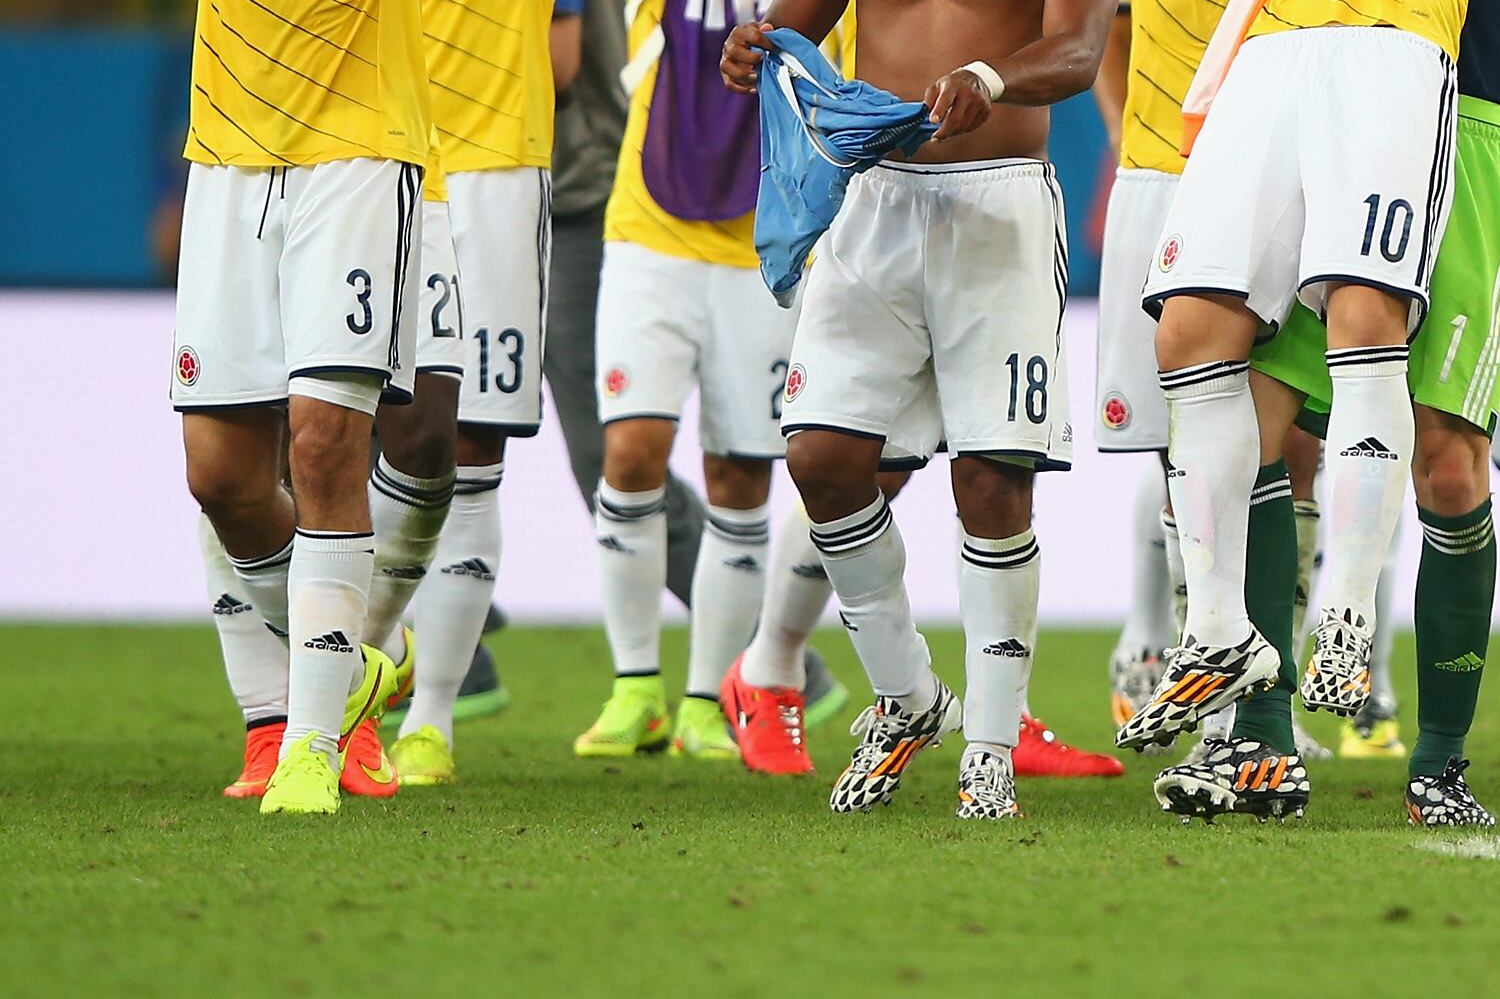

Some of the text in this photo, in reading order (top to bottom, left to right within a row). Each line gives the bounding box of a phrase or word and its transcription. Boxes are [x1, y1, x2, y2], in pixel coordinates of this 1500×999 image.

[1362, 194, 1413, 263] 10
[346, 269, 372, 335] 3
[427, 273, 463, 340] 21
[474, 328, 524, 394] 13
[1439, 314, 1468, 384] 1
[1005, 353, 1047, 424] 18
[1340, 449, 1398, 460] adidas
[303, 640, 354, 653] adidas
[982, 647, 1030, 658] adidas
